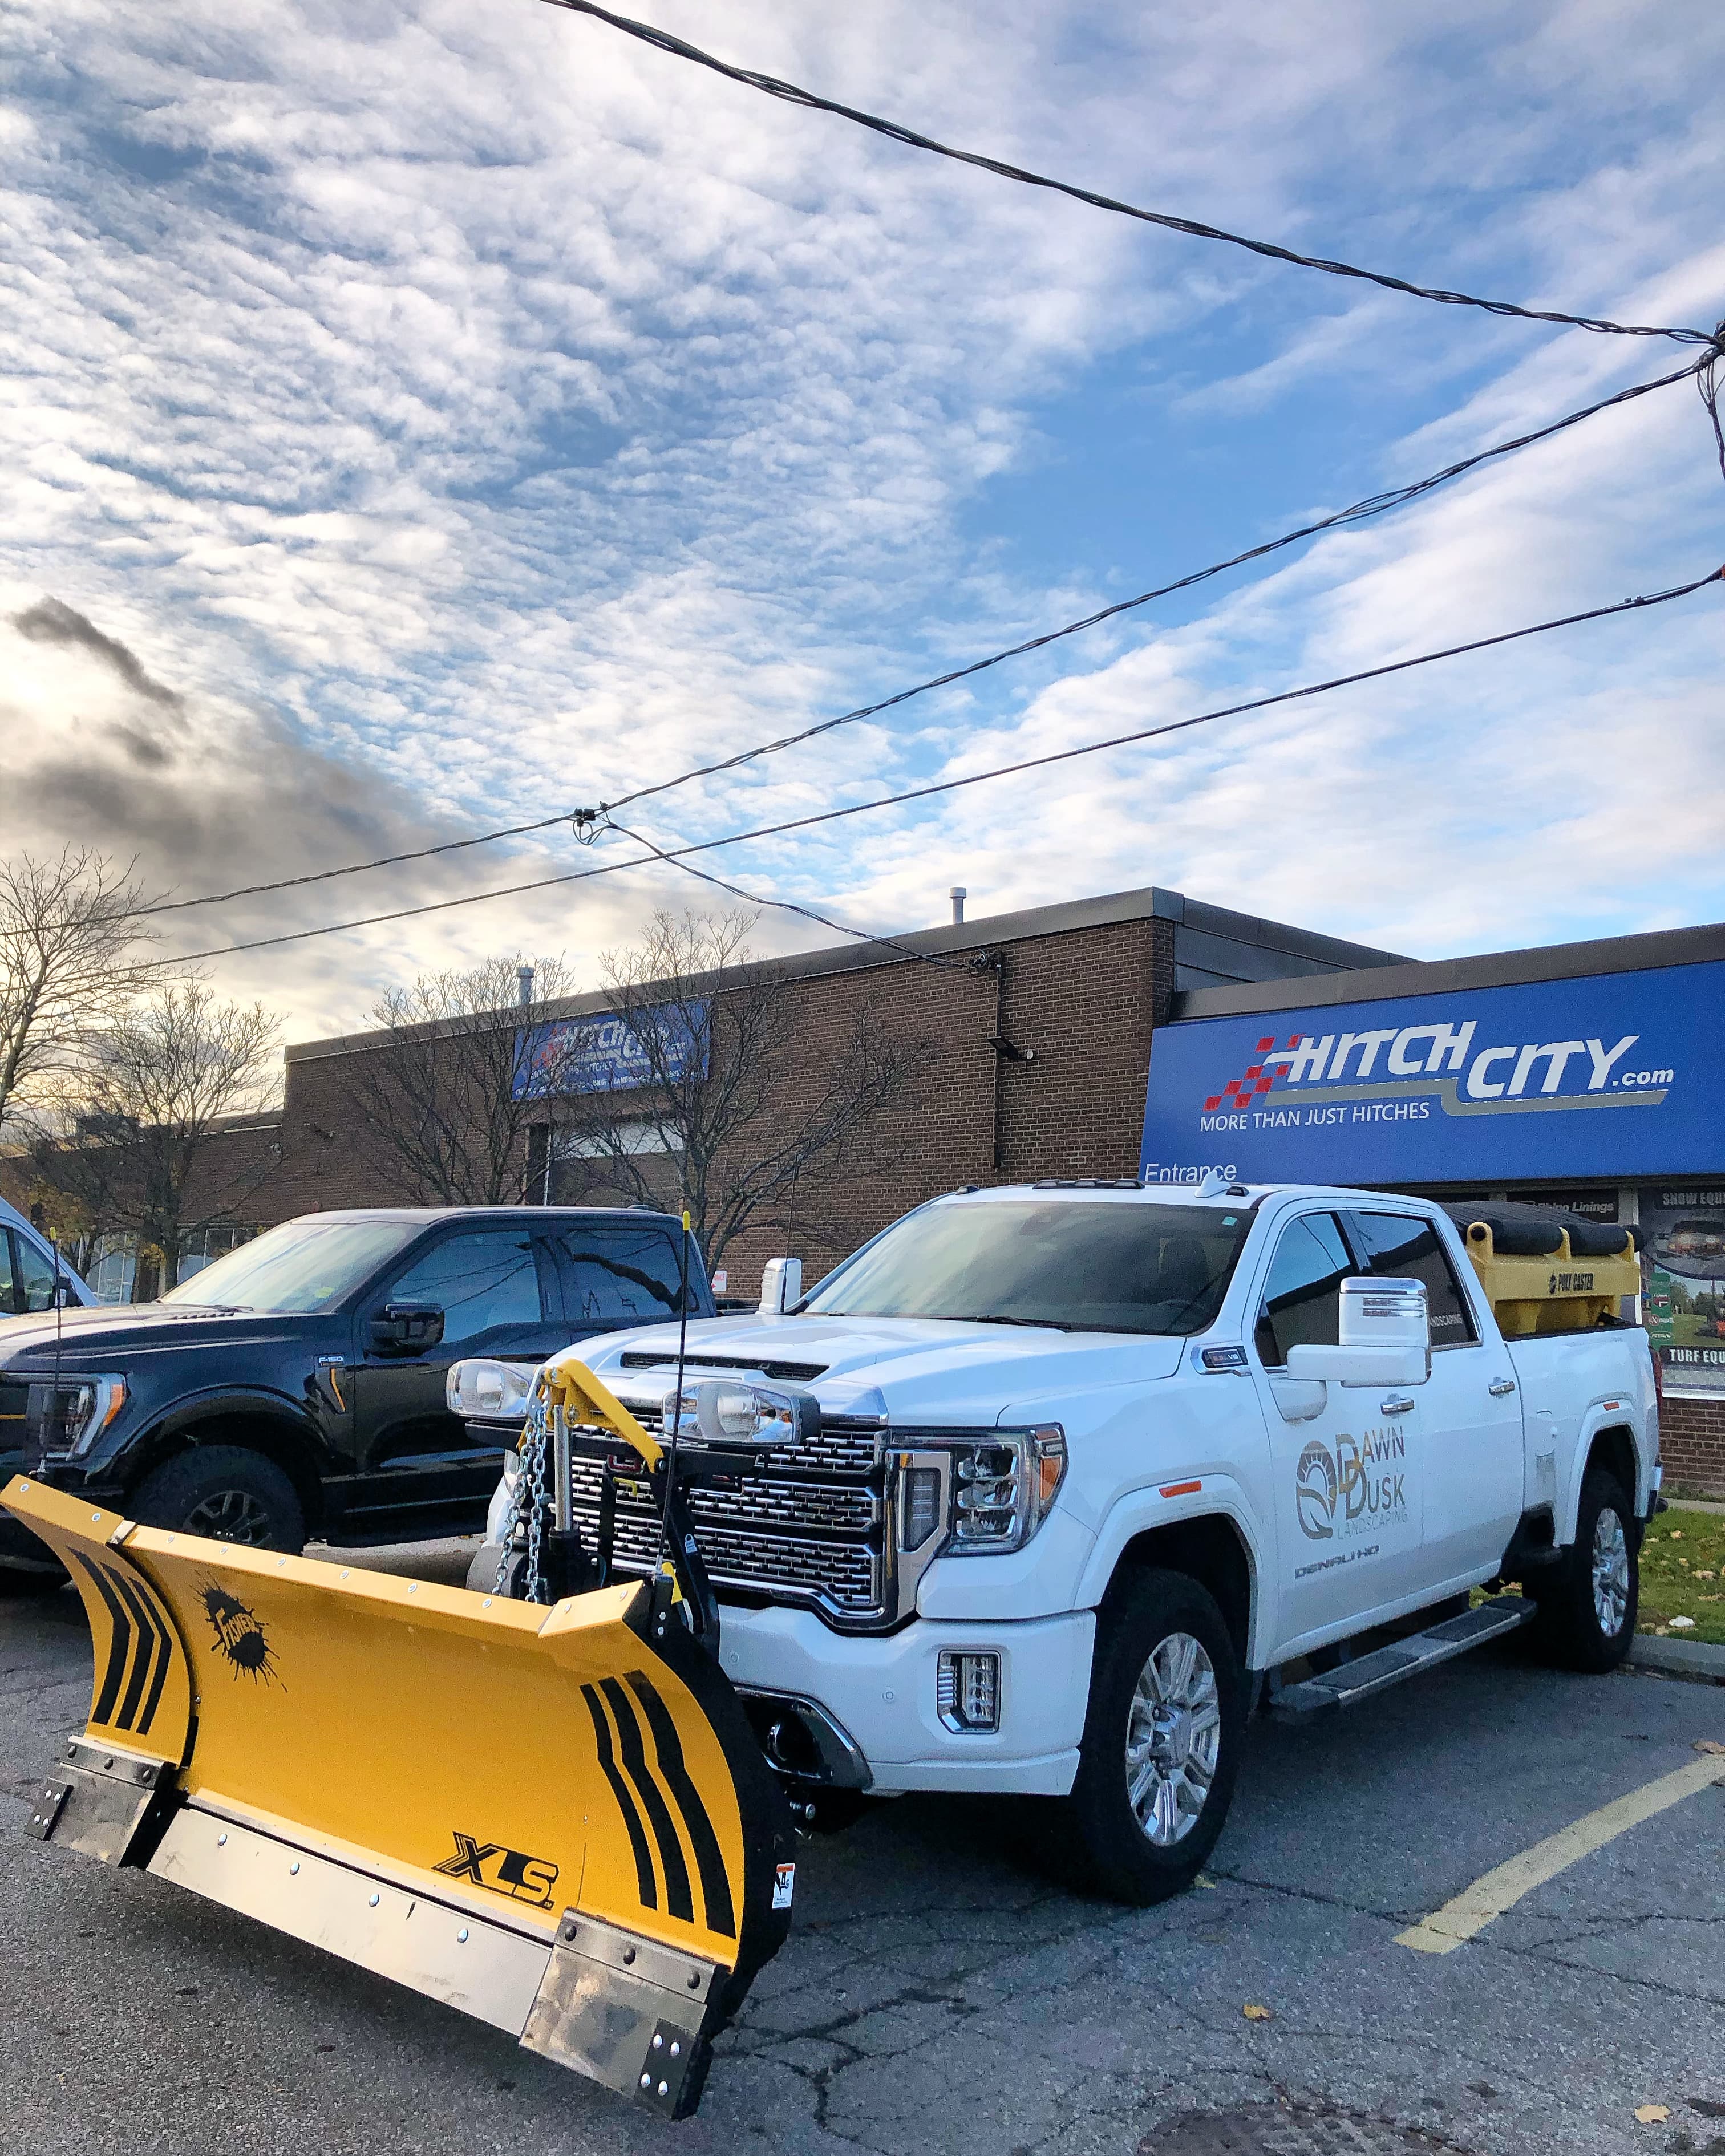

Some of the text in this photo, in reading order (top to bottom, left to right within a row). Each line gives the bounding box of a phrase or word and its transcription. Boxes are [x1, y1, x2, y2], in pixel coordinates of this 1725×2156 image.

[1262, 1020, 1477, 1083] HITCH
[1200, 1102, 1430, 1132] MORE THAN JUST HITCHES
[1572, 1201, 1615, 1214] Linings
[1428, 1313, 1463, 1327] ANDSCAPING
[1669, 1348, 1700, 1363] TURF
[215, 1607, 260, 1651] FISHER
[431, 1831, 560, 1908] XLS
